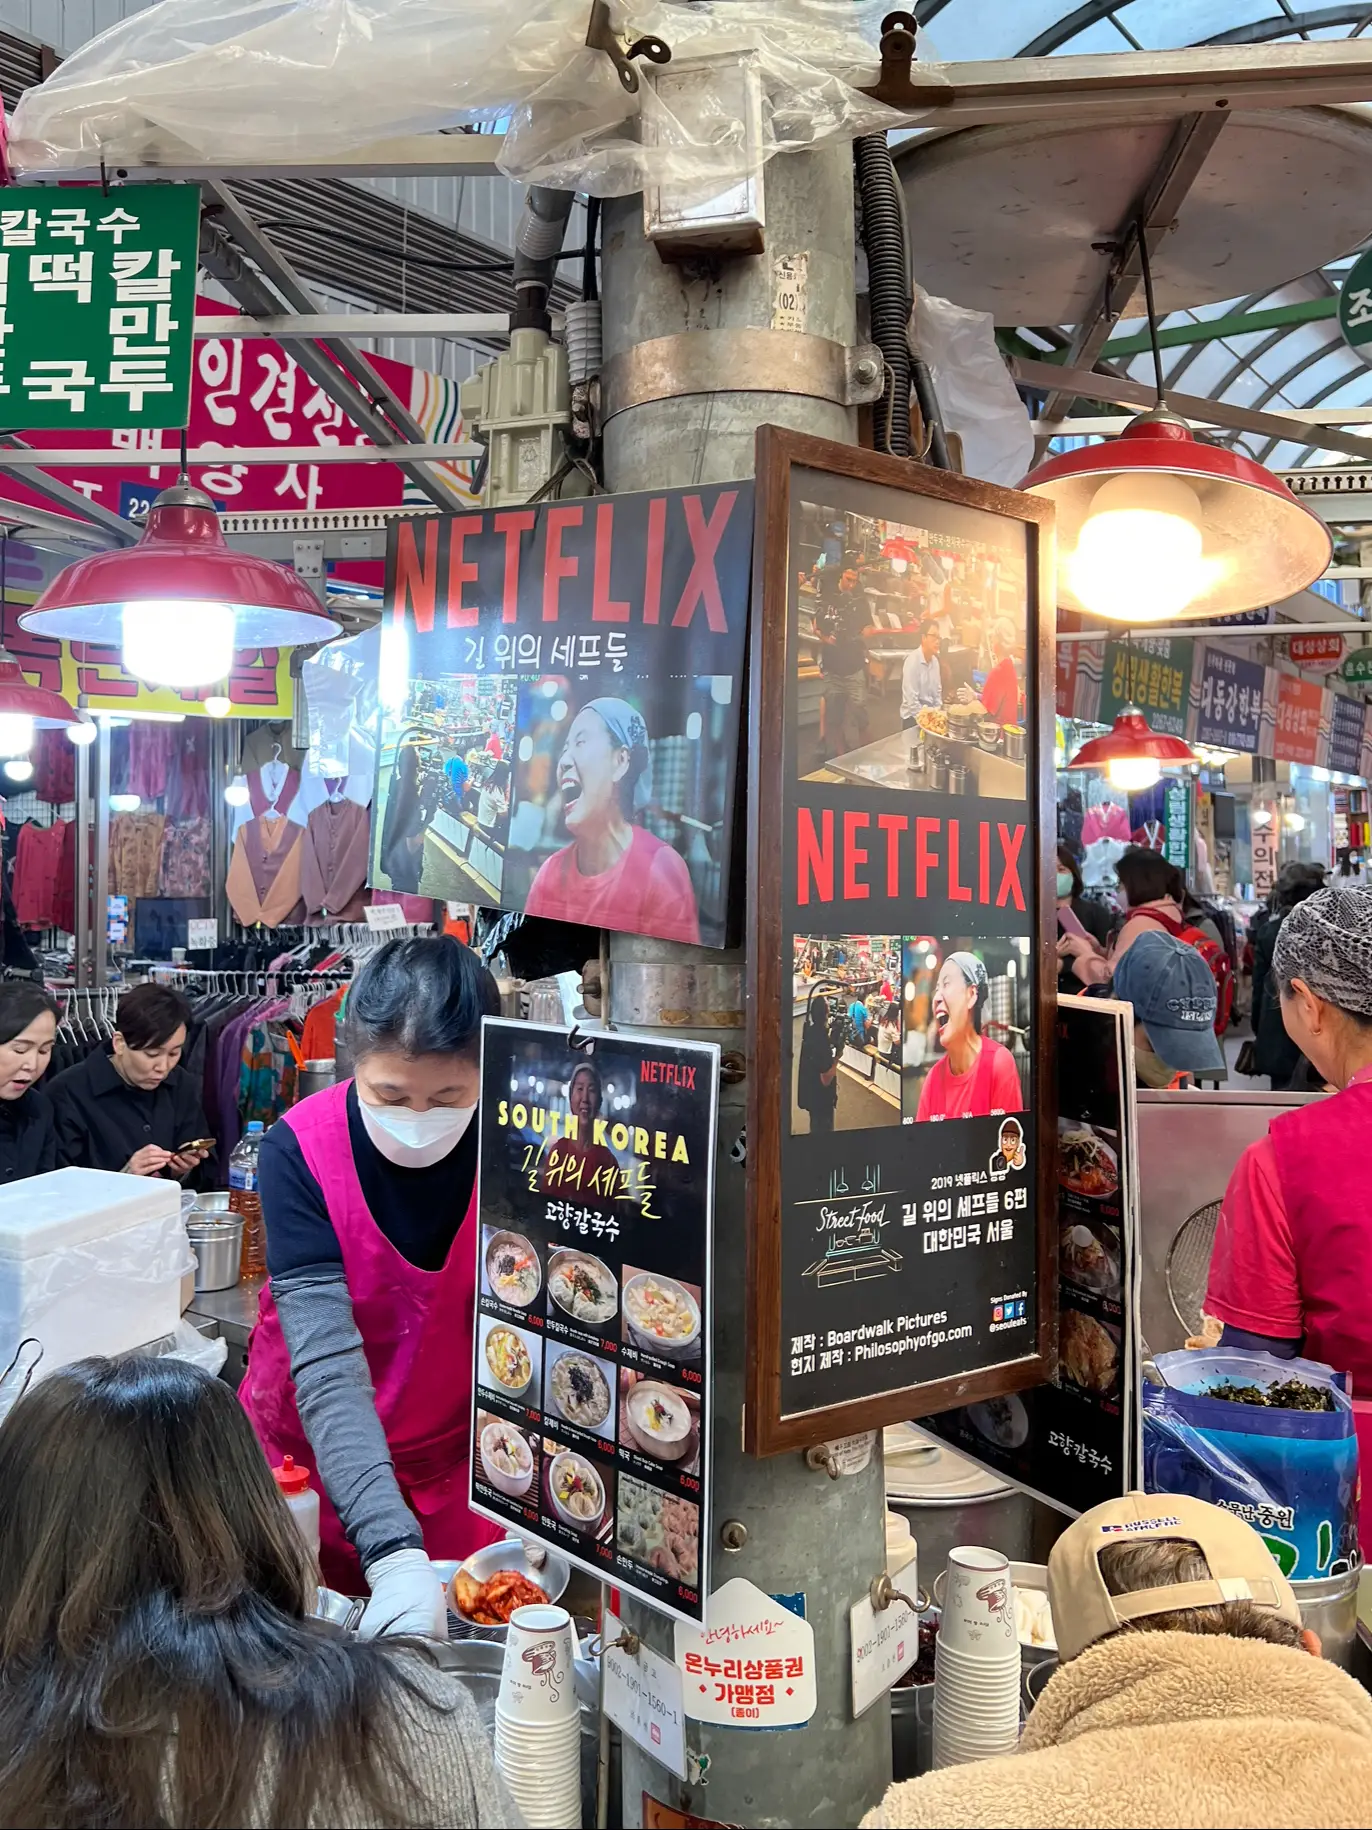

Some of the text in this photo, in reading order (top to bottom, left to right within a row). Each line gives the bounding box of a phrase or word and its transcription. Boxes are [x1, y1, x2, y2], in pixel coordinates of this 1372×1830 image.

[393, 490, 739, 633] NETFLIX
[465, 636, 485, 670] 길
[494, 633, 542, 669] 위의
[1292, 638, 1340, 655] 대성상회
[1201, 676, 1260, 730] 대동강한복
[797, 807, 1026, 911] NETFLIX
[641, 1060, 697, 1090] NETFLIX
[498, 1100, 690, 1164] SOUTH KOREA
[521, 1137, 549, 1193] 길
[545, 1149, 587, 1191] 위의
[931, 1176, 953, 1190] 2019
[955, 1170, 988, 1187] 넷플릭스
[816, 1200, 890, 1234] Street Food
[902, 1203, 917, 1226] 길
[922, 1198, 952, 1223] 위의
[1004, 1187, 1027, 1210] 6편
[545, 1200, 620, 1242] 고향칼국수
[923, 1218, 1014, 1254] 대한민국 서울
[480, 1297, 498, 1310] 손칼국수
[528, 1314, 544, 1328] 6,000
[546, 1318, 569, 1335] 만두칼국수
[791, 1333, 816, 1355] 제작
[828, 1320, 894, 1348] Boardwalk
[897, 1310, 948, 1331] Pictures
[600, 1338, 618, 1353] 7,000
[621, 1346, 638, 1361] 수제비
[819, 1347, 844, 1370] 제작
[855, 1323, 973, 1361] Philosophyofgo.com
[681, 1368, 702, 1383] 6,000
[597, 1439, 615, 1455] 6,000
[1048, 1431, 1112, 1475] 고향칼국수
[679, 1474, 700, 1491] 6,000
[596, 1544, 613, 1560] 7,000
[616, 1554, 633, 1570] 손만두
[677, 1585, 698, 1603] 6,000
[685, 1652, 804, 1679] 온누리상품권
[715, 1683, 775, 1705] 가맹점
[731, 1707, 760, 1718] (종이)
